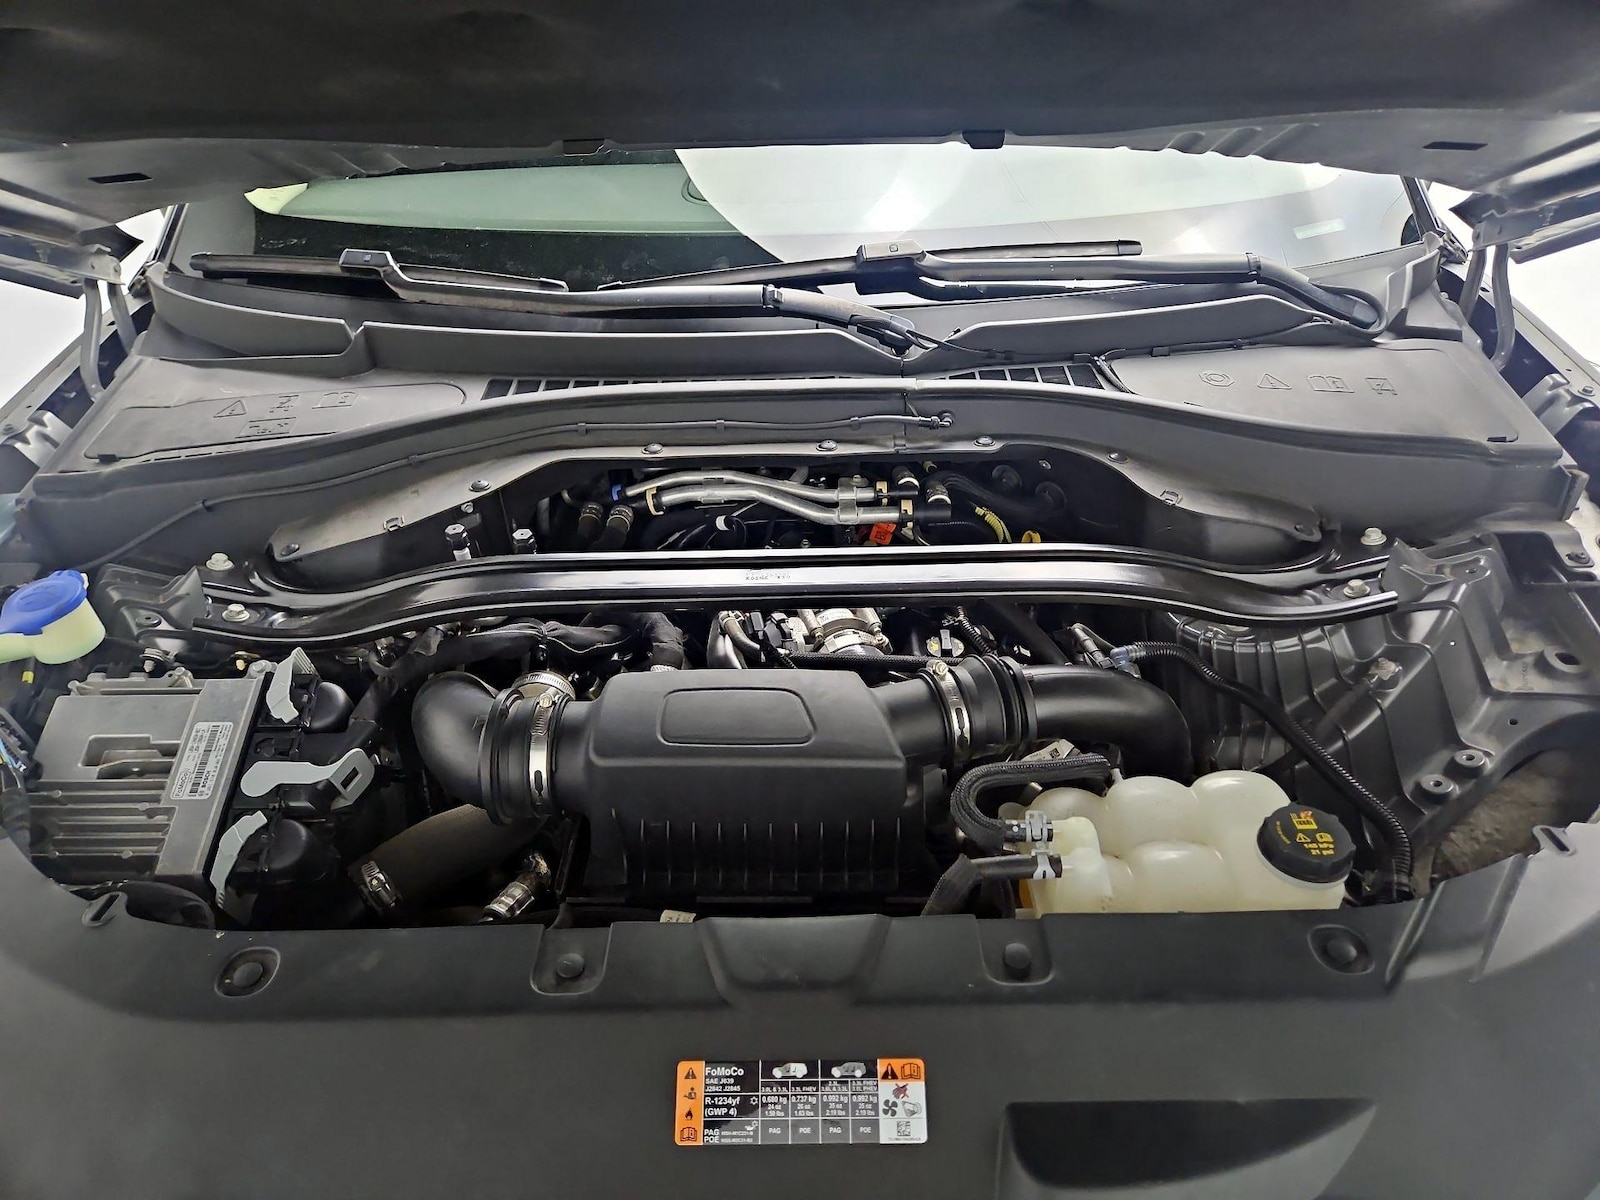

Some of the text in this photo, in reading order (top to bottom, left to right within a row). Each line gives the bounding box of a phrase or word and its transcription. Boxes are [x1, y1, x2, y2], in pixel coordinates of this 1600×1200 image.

[201, 770, 211, 788] BOSCH
[175, 772, 189, 797] FoMoCo
[705, 1066, 744, 1076] FoMoCo
[705, 1096, 740, 1107] R-1234yf
[779, 1095, 788, 1105] kg
[791, 1095, 817, 1105] 0.737 kg
[840, 1095, 849, 1104] kg
[869, 1095, 878, 1104] kg
[704, 1107, 738, 1118] (GWP 4)
[704, 1128, 720, 1136] PAG
[704, 1136, 720, 1144] POE
